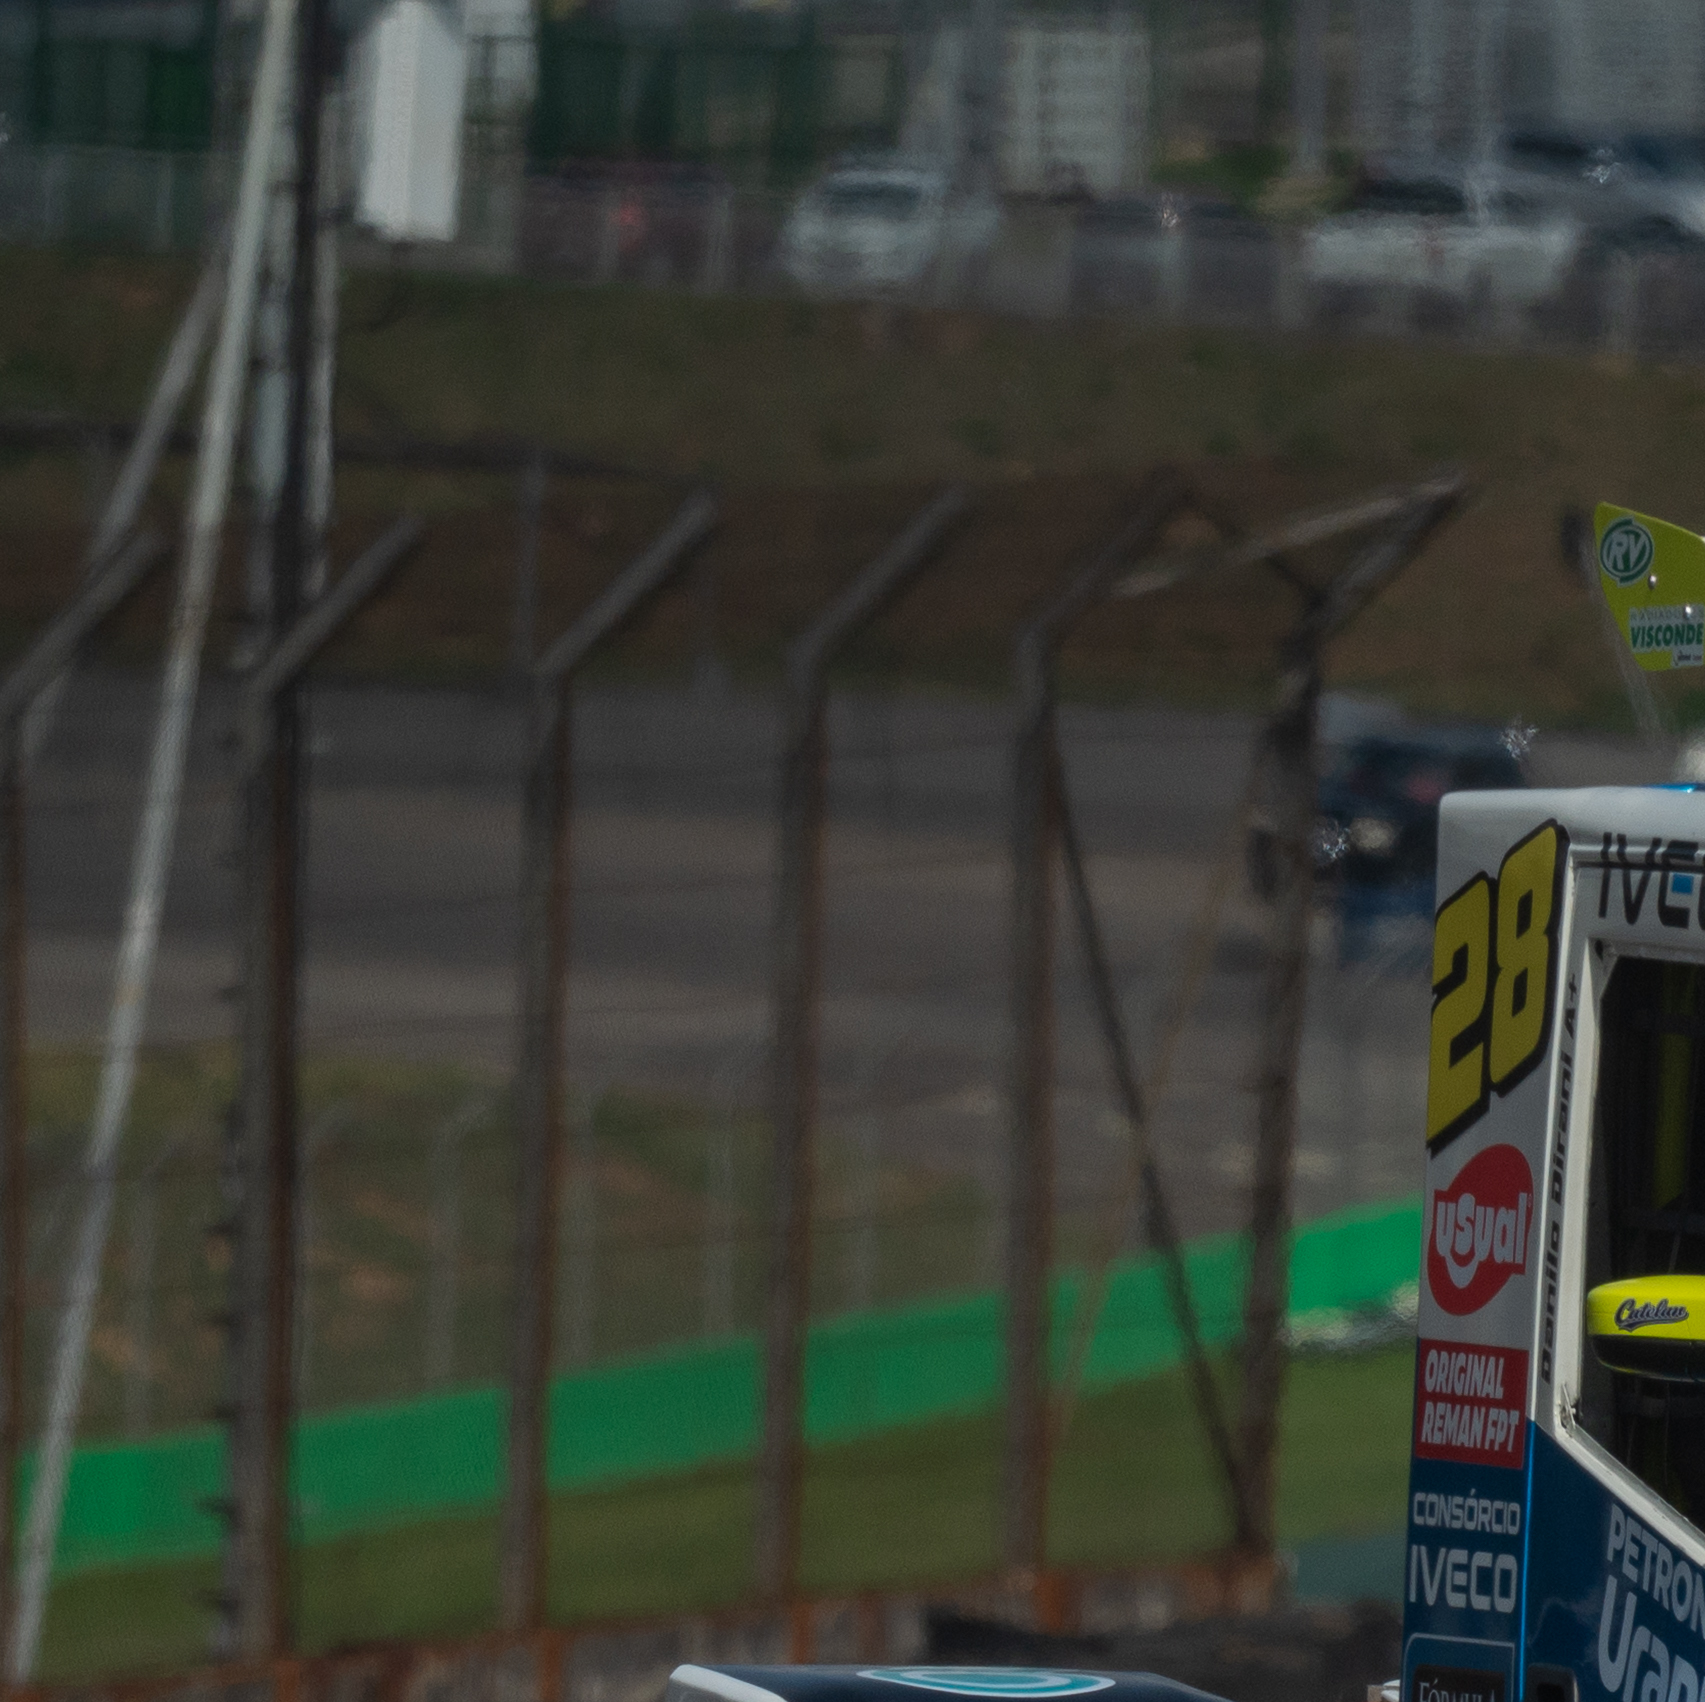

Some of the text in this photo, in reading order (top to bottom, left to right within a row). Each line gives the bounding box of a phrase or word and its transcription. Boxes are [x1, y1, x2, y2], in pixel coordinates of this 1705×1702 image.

[1630, 623, 1704, 649] VISCONDE
[1426, 822, 1562, 1150] 28
[1435, 1192, 1529, 1272] usual
[1425, 1349, 1506, 1400] ORIGINAL
[1421, 1406, 1520, 1453] REMAN FPT
[1412, 1488, 1521, 1535] CONSÓRCIO
[1409, 1543, 1519, 1614] IVECO
